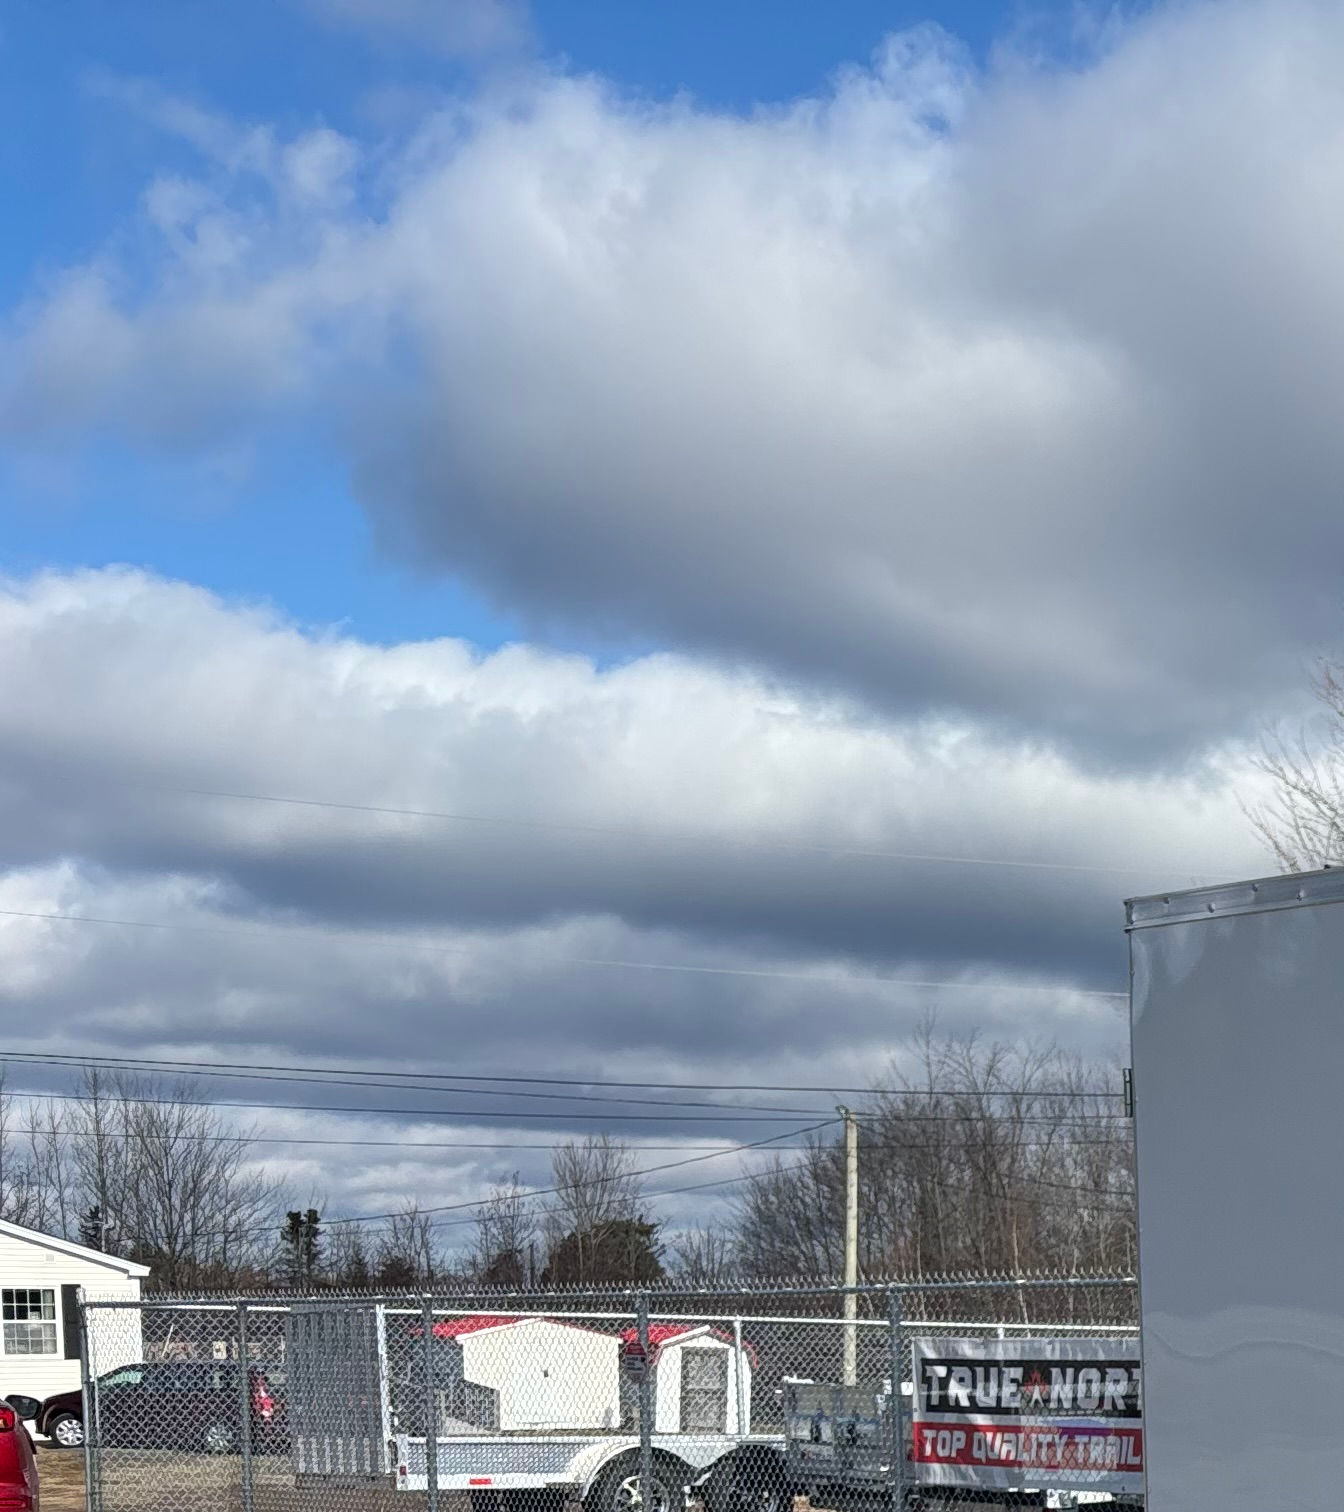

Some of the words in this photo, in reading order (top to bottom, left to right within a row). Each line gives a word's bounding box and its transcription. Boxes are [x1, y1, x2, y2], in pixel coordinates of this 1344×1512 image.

[922, 1365, 1024, 1408] TRUE
[922, 1429, 966, 1458] TOP
[973, 1431, 1068, 1464] QUALITY
